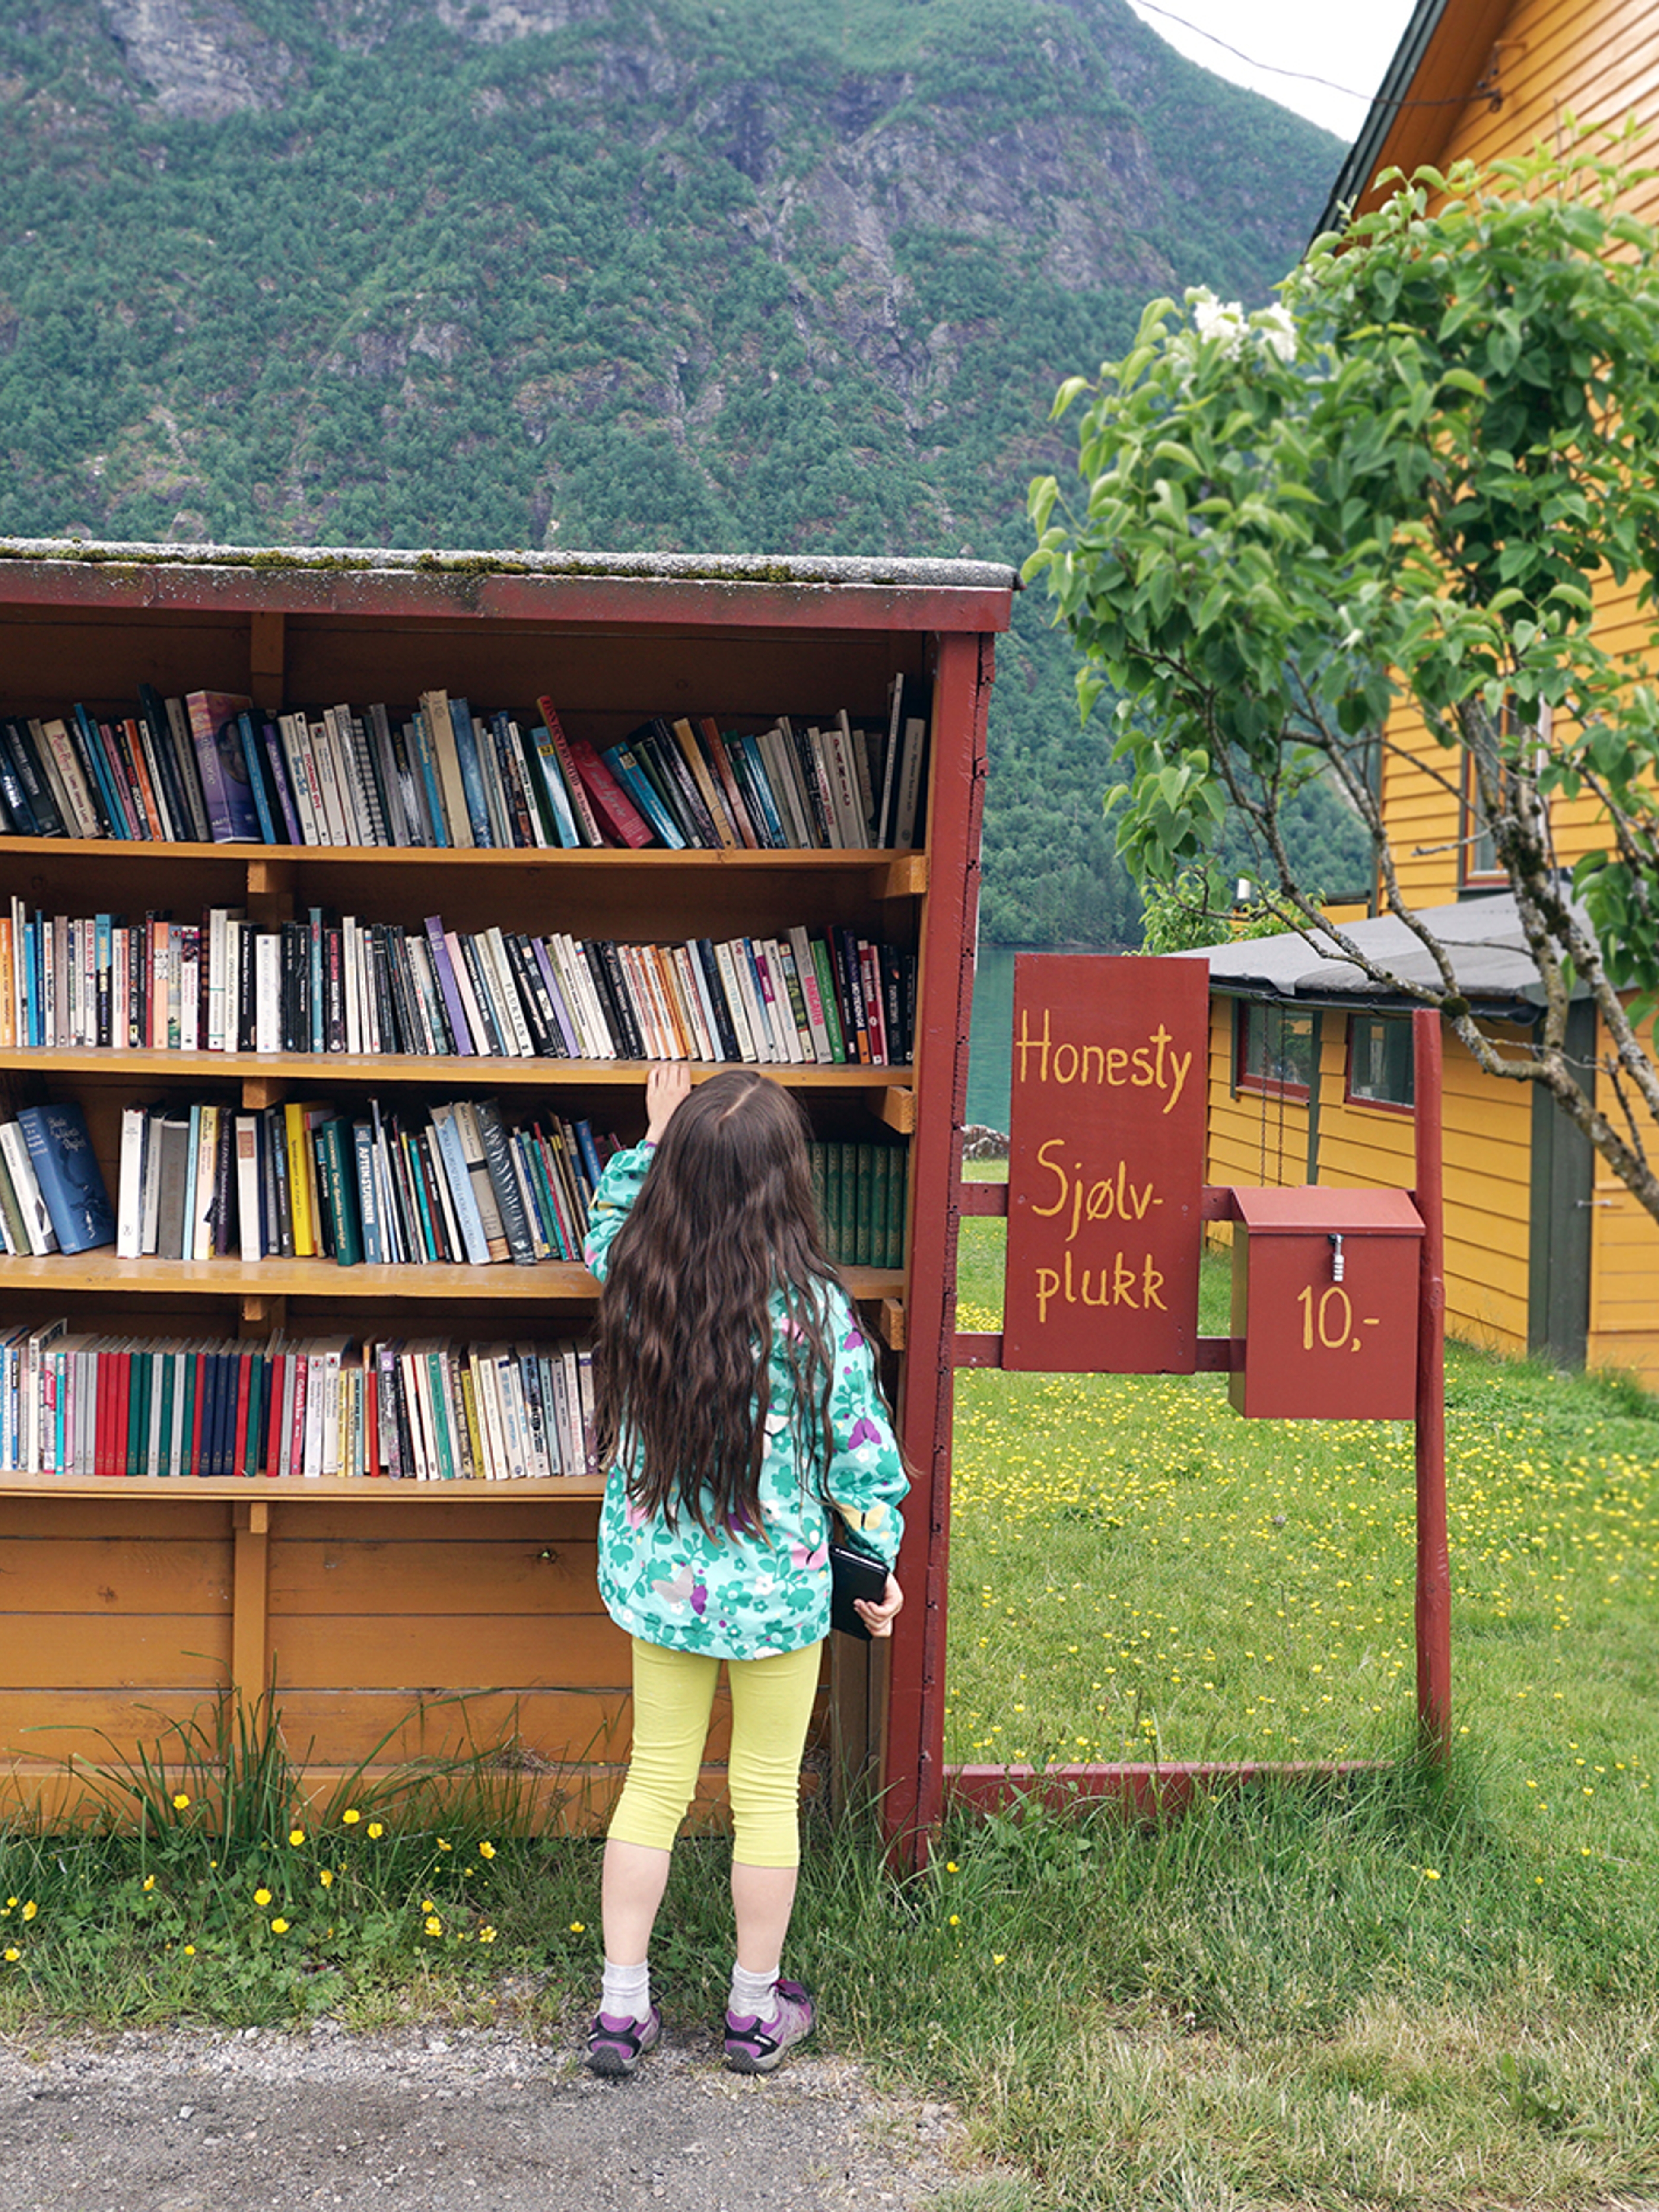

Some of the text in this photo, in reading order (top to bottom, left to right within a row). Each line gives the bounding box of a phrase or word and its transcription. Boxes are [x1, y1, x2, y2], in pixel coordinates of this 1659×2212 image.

[505, 982, 525, 1037] FLUKTEN
[1017, 1010, 1191, 1113] Honesty
[1033, 1140, 1163, 1240] Sjølv-
[1036, 1252, 1166, 1322] plukk
[1298, 1286, 1379, 1351] 10,-
